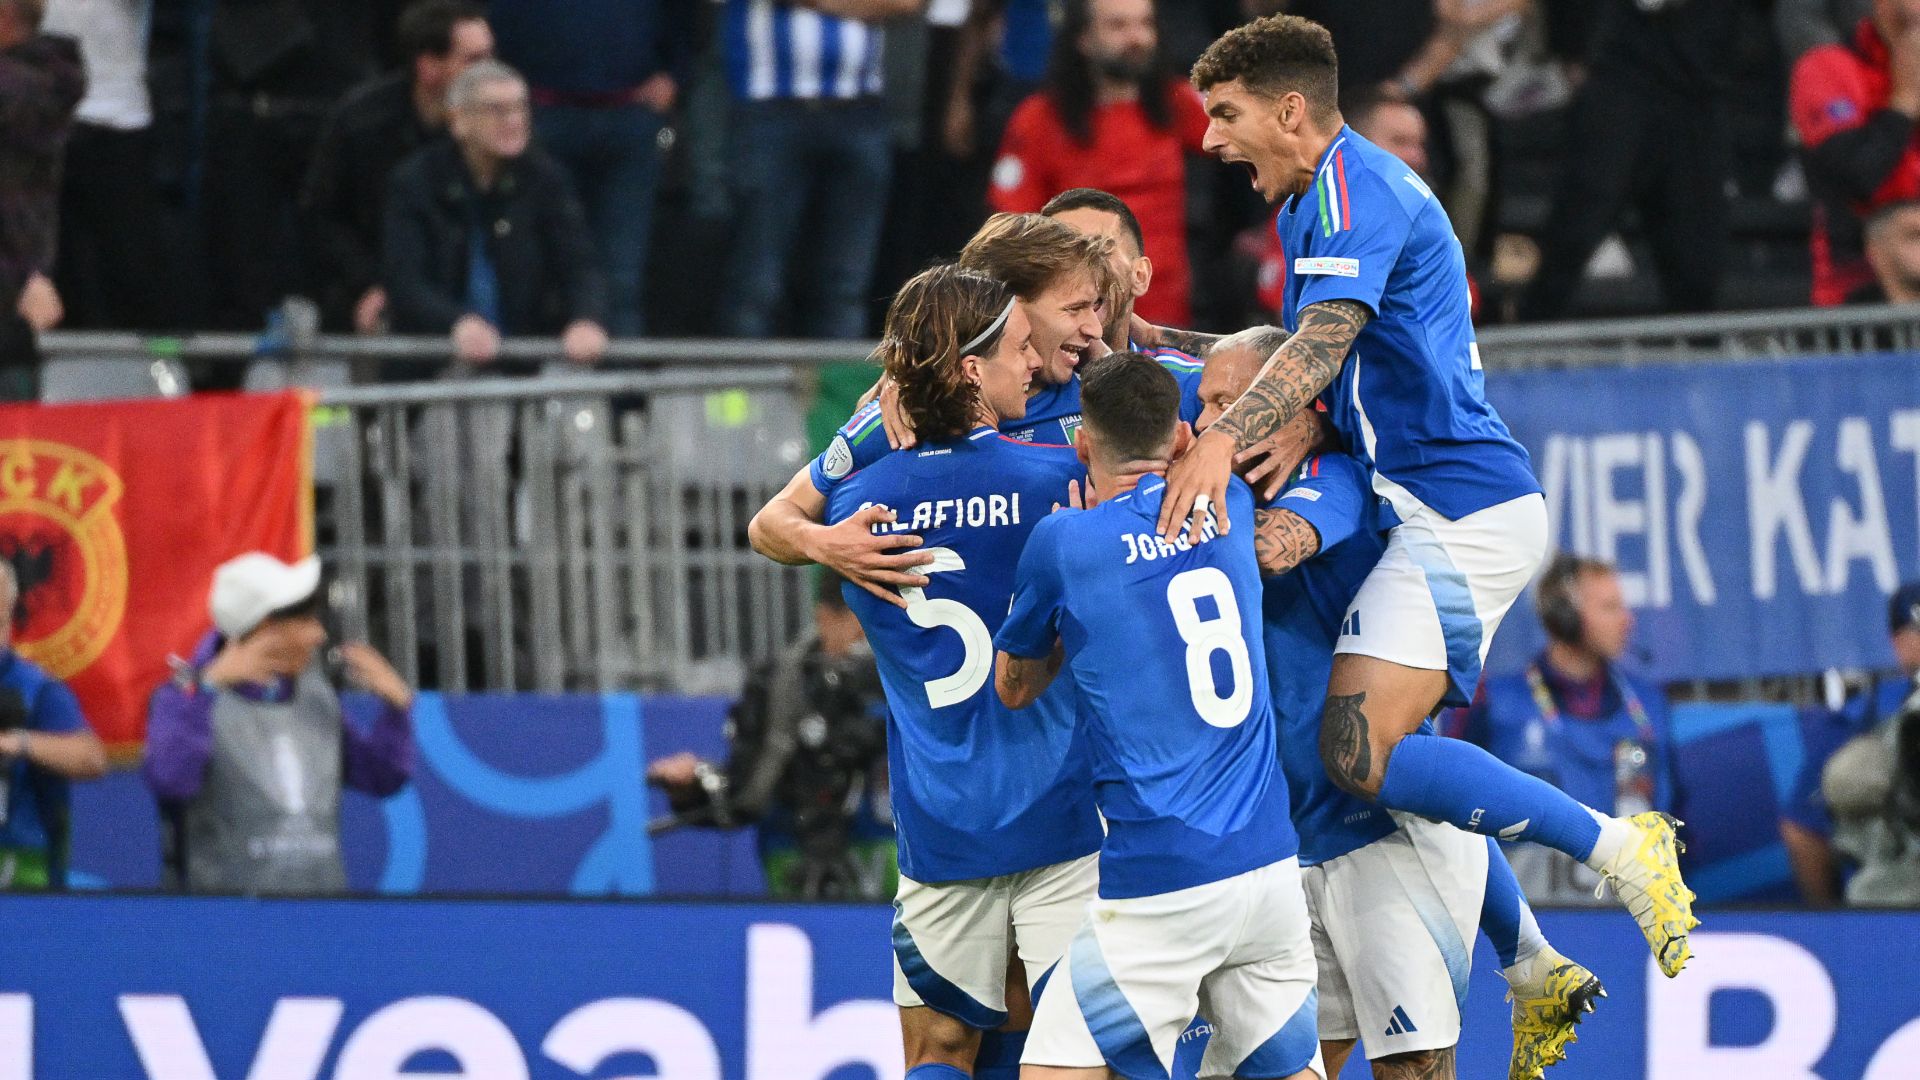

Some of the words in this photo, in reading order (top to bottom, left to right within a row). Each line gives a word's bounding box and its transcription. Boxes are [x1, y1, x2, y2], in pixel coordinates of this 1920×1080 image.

[858, 492, 1020, 534] LAFIORI
[1121, 501, 1231, 564] JORGH
[898, 547, 993, 709] 5
[1167, 566, 1254, 728] 8
